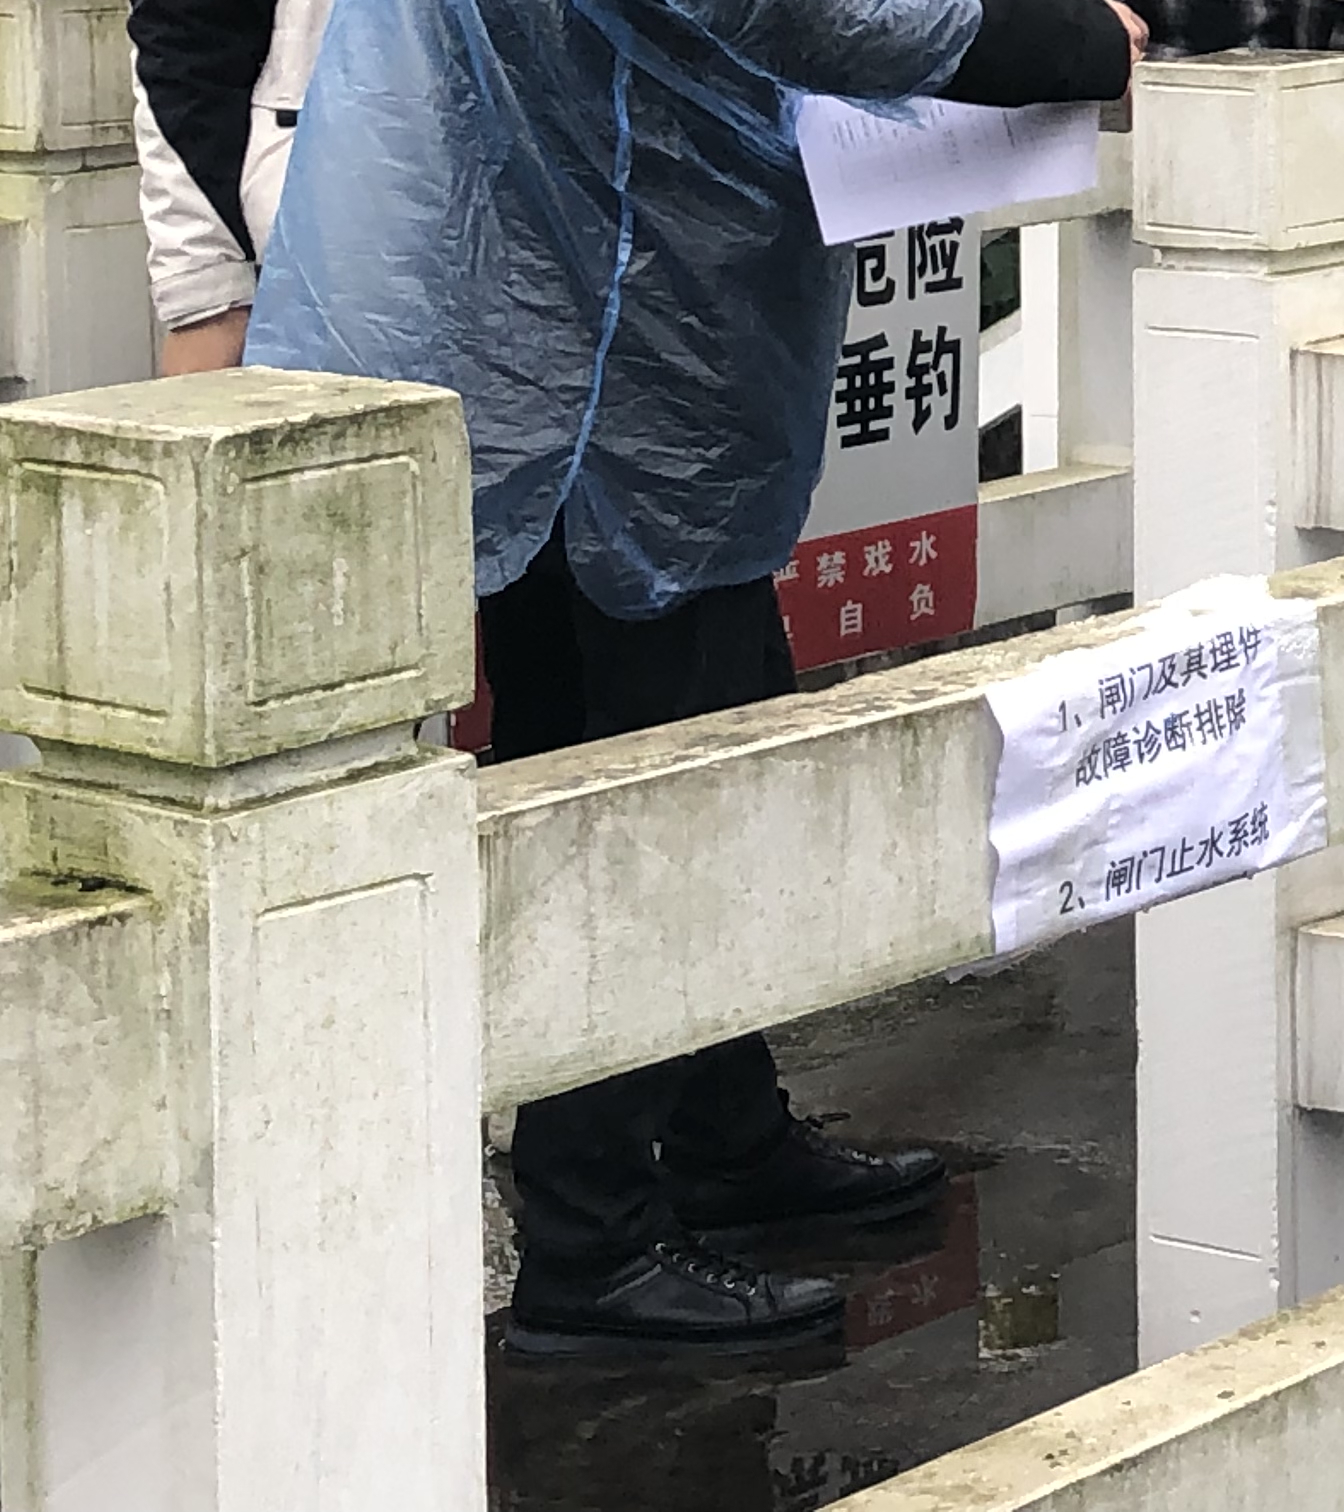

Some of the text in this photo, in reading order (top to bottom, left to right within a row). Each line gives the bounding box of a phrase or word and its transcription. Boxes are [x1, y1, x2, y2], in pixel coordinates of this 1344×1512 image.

[834, 326, 961, 449] 垂钓
[1075, 687, 1247, 788] 故障诊断排除
[1058, 801, 1270, 915] 2、闸门止水系统
